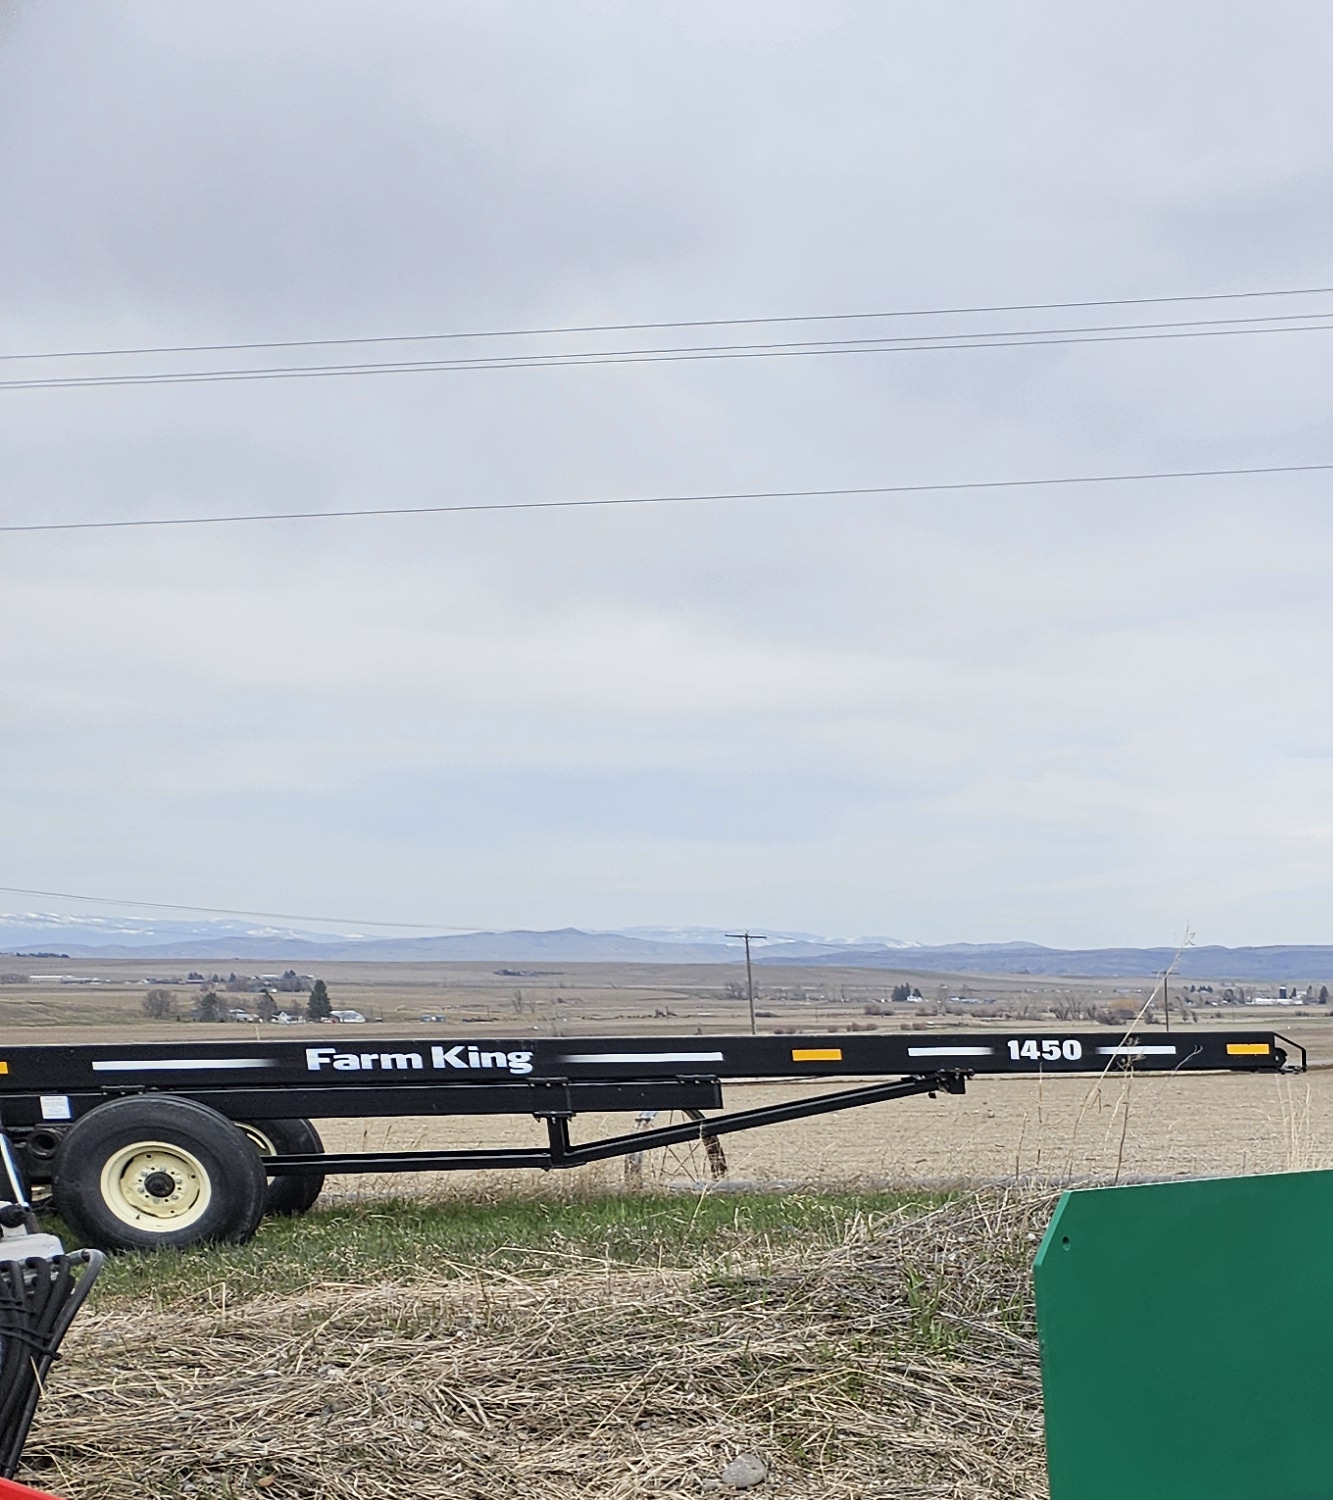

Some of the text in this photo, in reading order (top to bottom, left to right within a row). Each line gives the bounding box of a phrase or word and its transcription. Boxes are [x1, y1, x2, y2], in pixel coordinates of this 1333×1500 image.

[306, 1045, 533, 1075] Farm King
[1007, 1039, 1083, 1061] 1450
